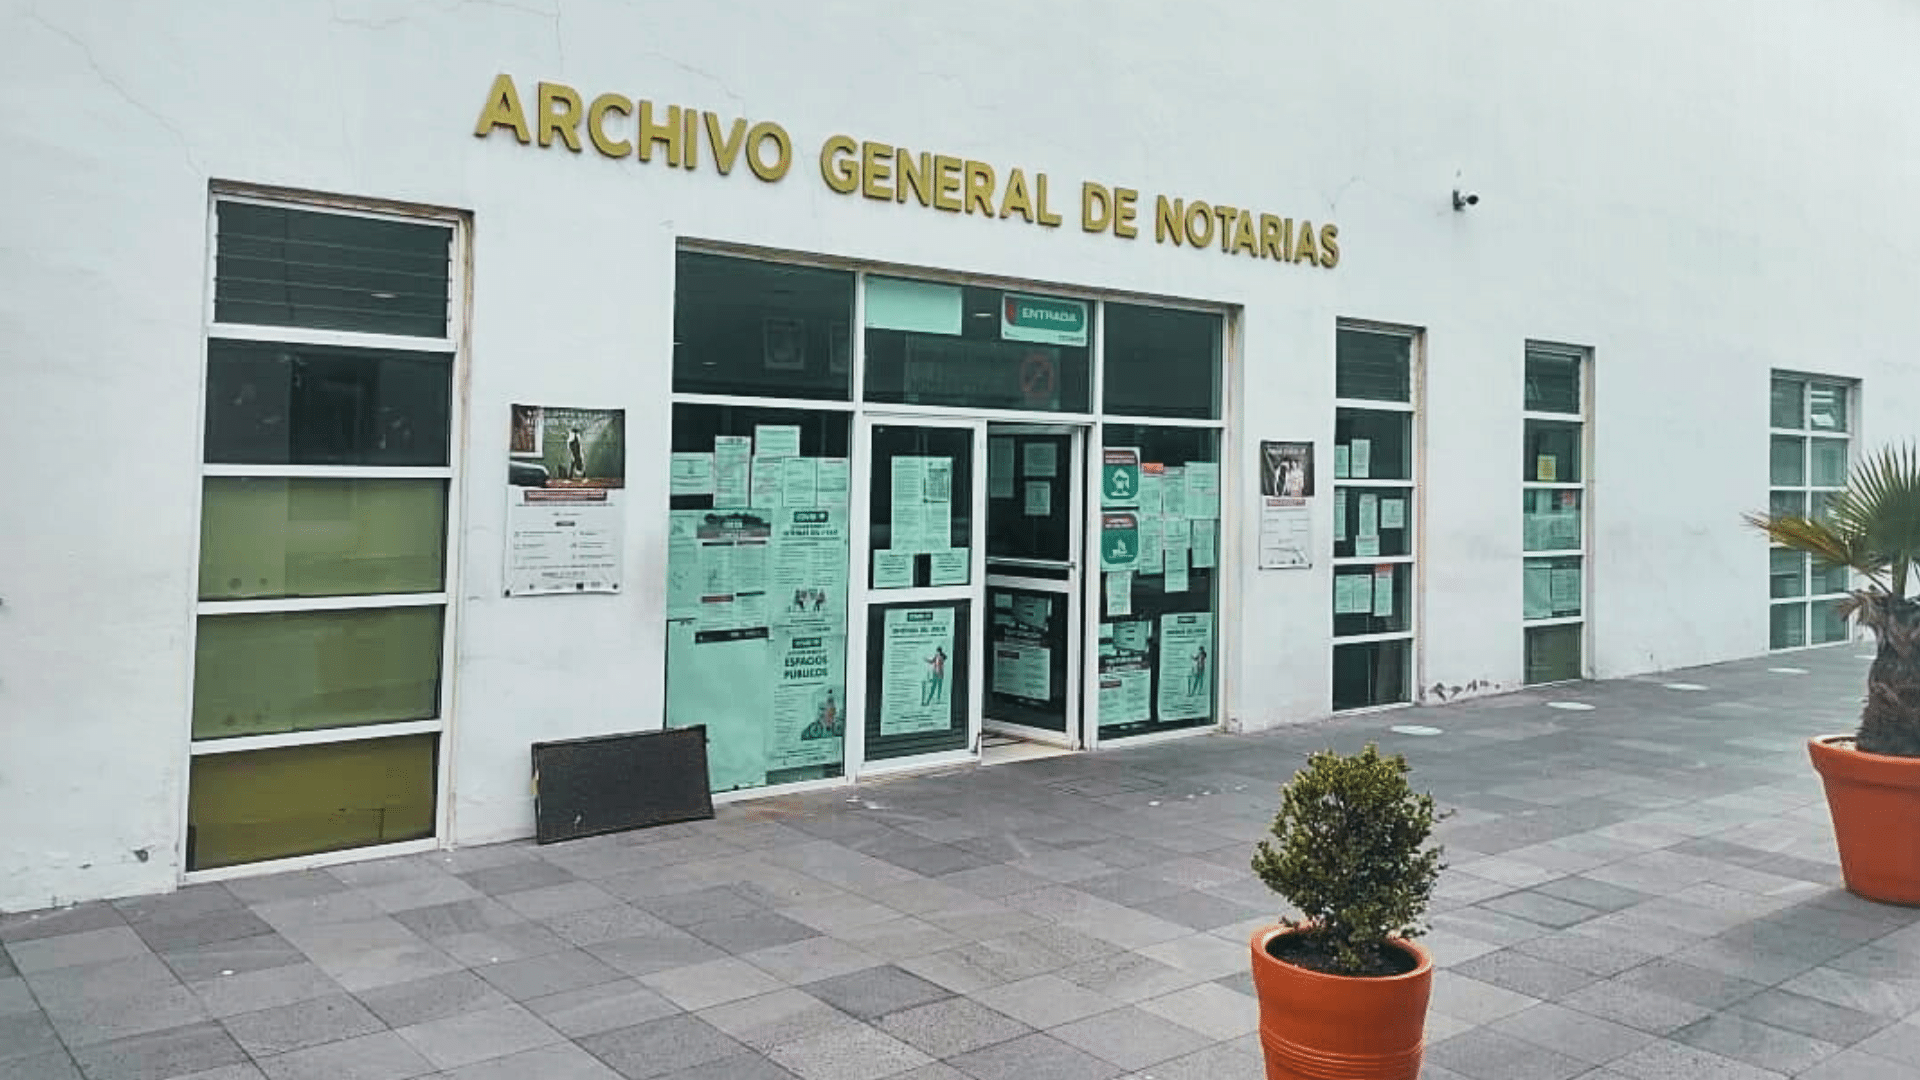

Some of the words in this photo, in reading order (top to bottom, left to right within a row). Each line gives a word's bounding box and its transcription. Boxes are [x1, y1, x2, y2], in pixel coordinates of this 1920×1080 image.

[474, 73, 793, 182] ARCHIVO
[820, 134, 1062, 227] GENERAL
[1082, 181, 1138, 239] DE
[1155, 194, 1340, 269] NOTARIAS
[1022, 307, 1078, 322] ENTRADA
